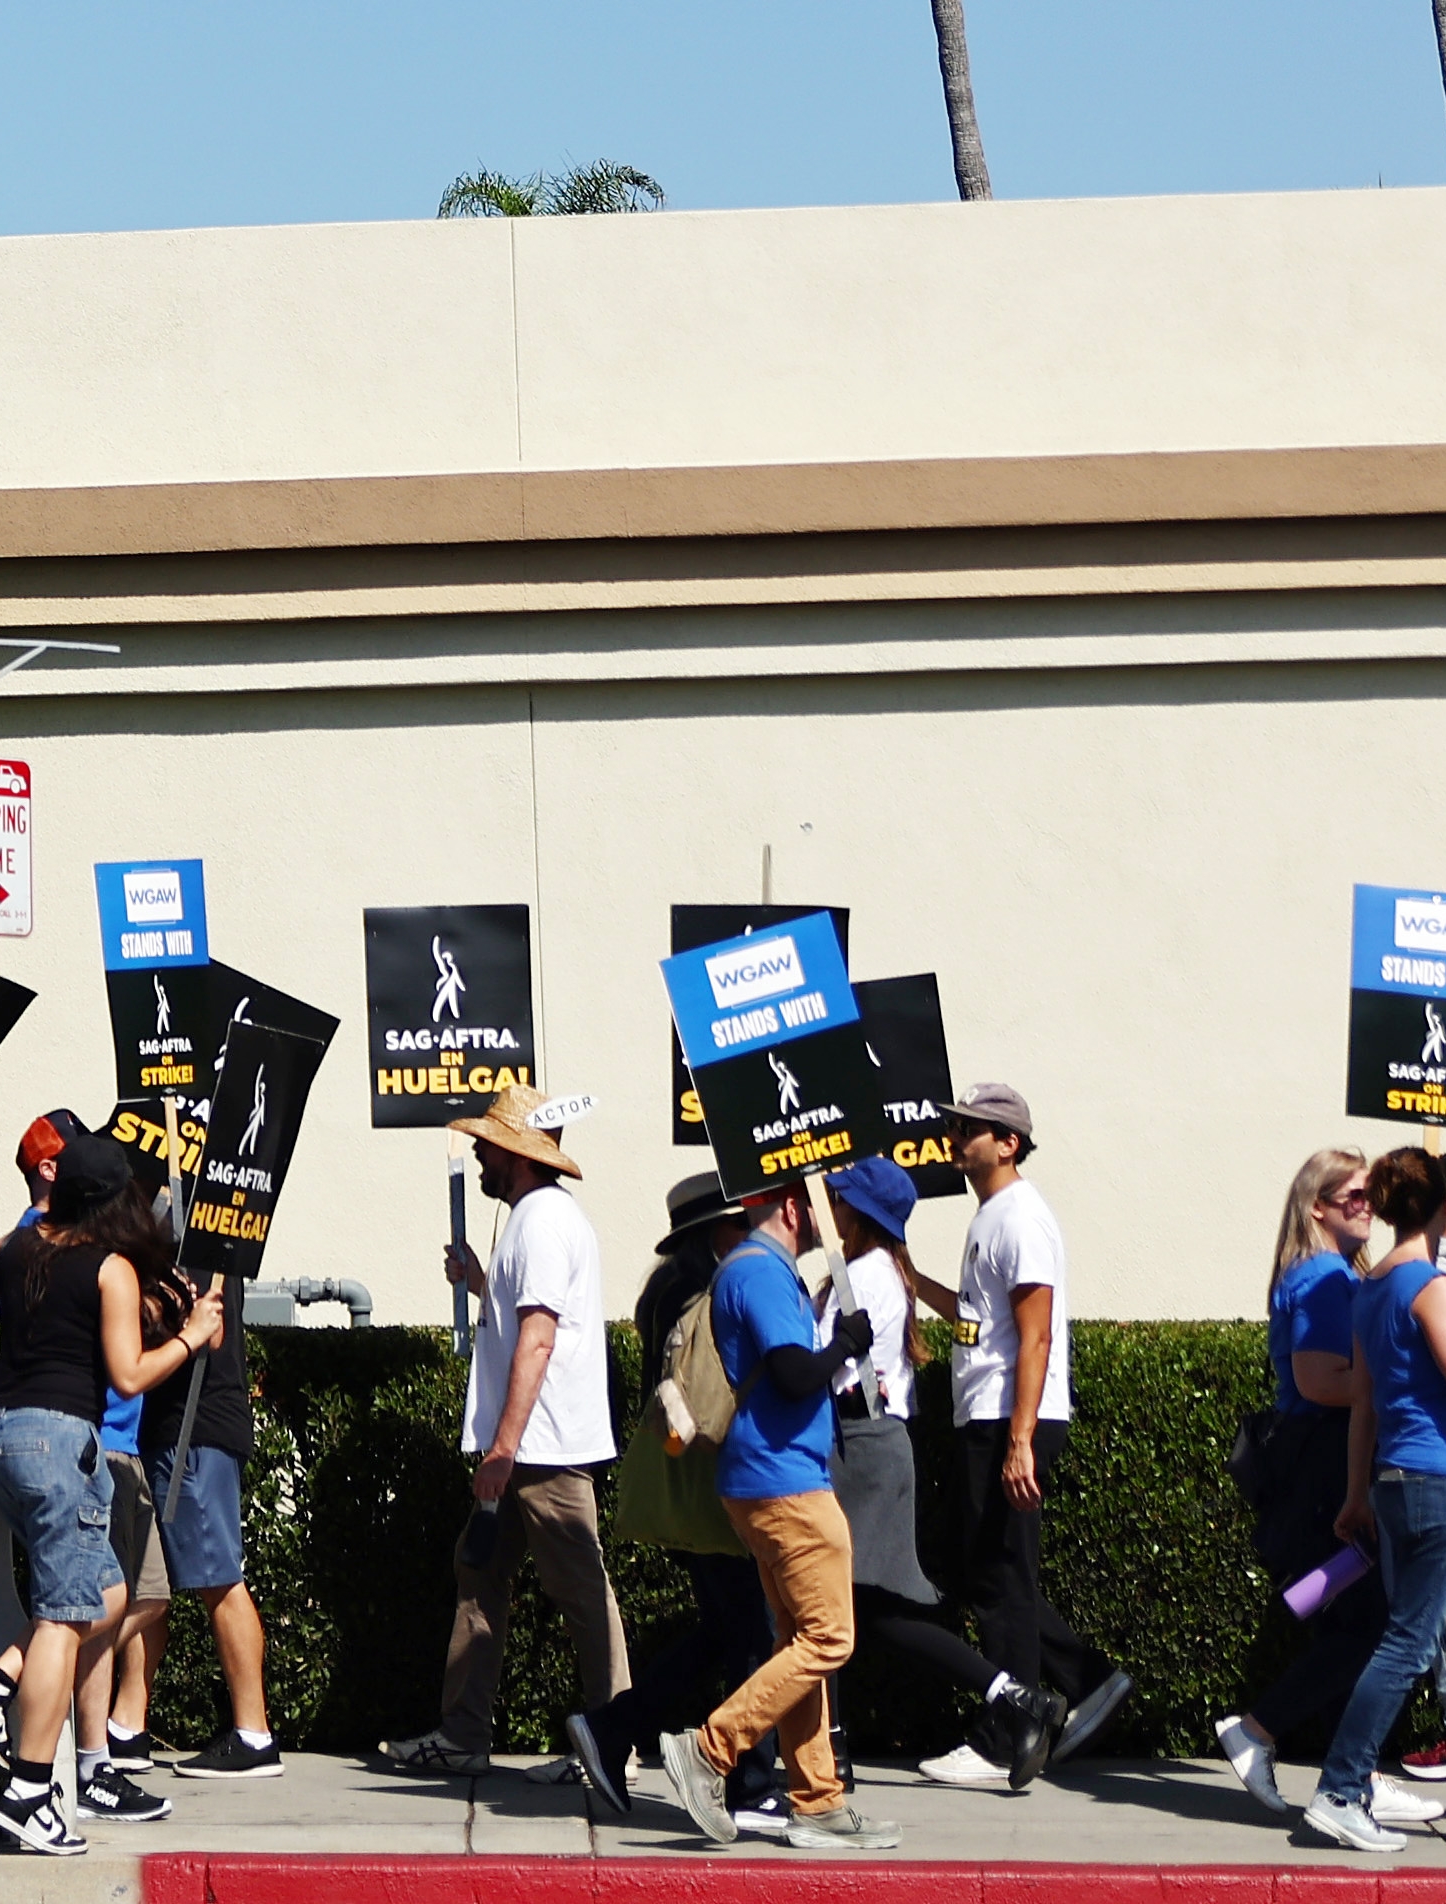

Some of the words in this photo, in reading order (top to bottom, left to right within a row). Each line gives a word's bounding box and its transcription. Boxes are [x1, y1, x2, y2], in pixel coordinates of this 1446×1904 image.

[128, 887, 178, 905] WGAW
[121, 931, 164, 959] STANDS
[165, 929, 193, 957] WITH
[714, 953, 793, 989] WGAW
[710, 1006, 779, 1048] STANDS
[778, 991, 828, 1028] WITH
[161, 1056, 174, 1066] ON
[440, 1051, 465, 1066] EN
[140, 1064, 194, 1087] STRIKE!
[377, 1066, 530, 1095] HUELGA!
[1422, 1083, 1443, 1095] ON
[533, 1095, 594, 1126] ACTOR
[791, 1131, 812, 1145] ON
[759, 1131, 852, 1176] STRIKE!
[231, 1190, 247, 1206] EN
[189, 1201, 269, 1242] HUELGA!
